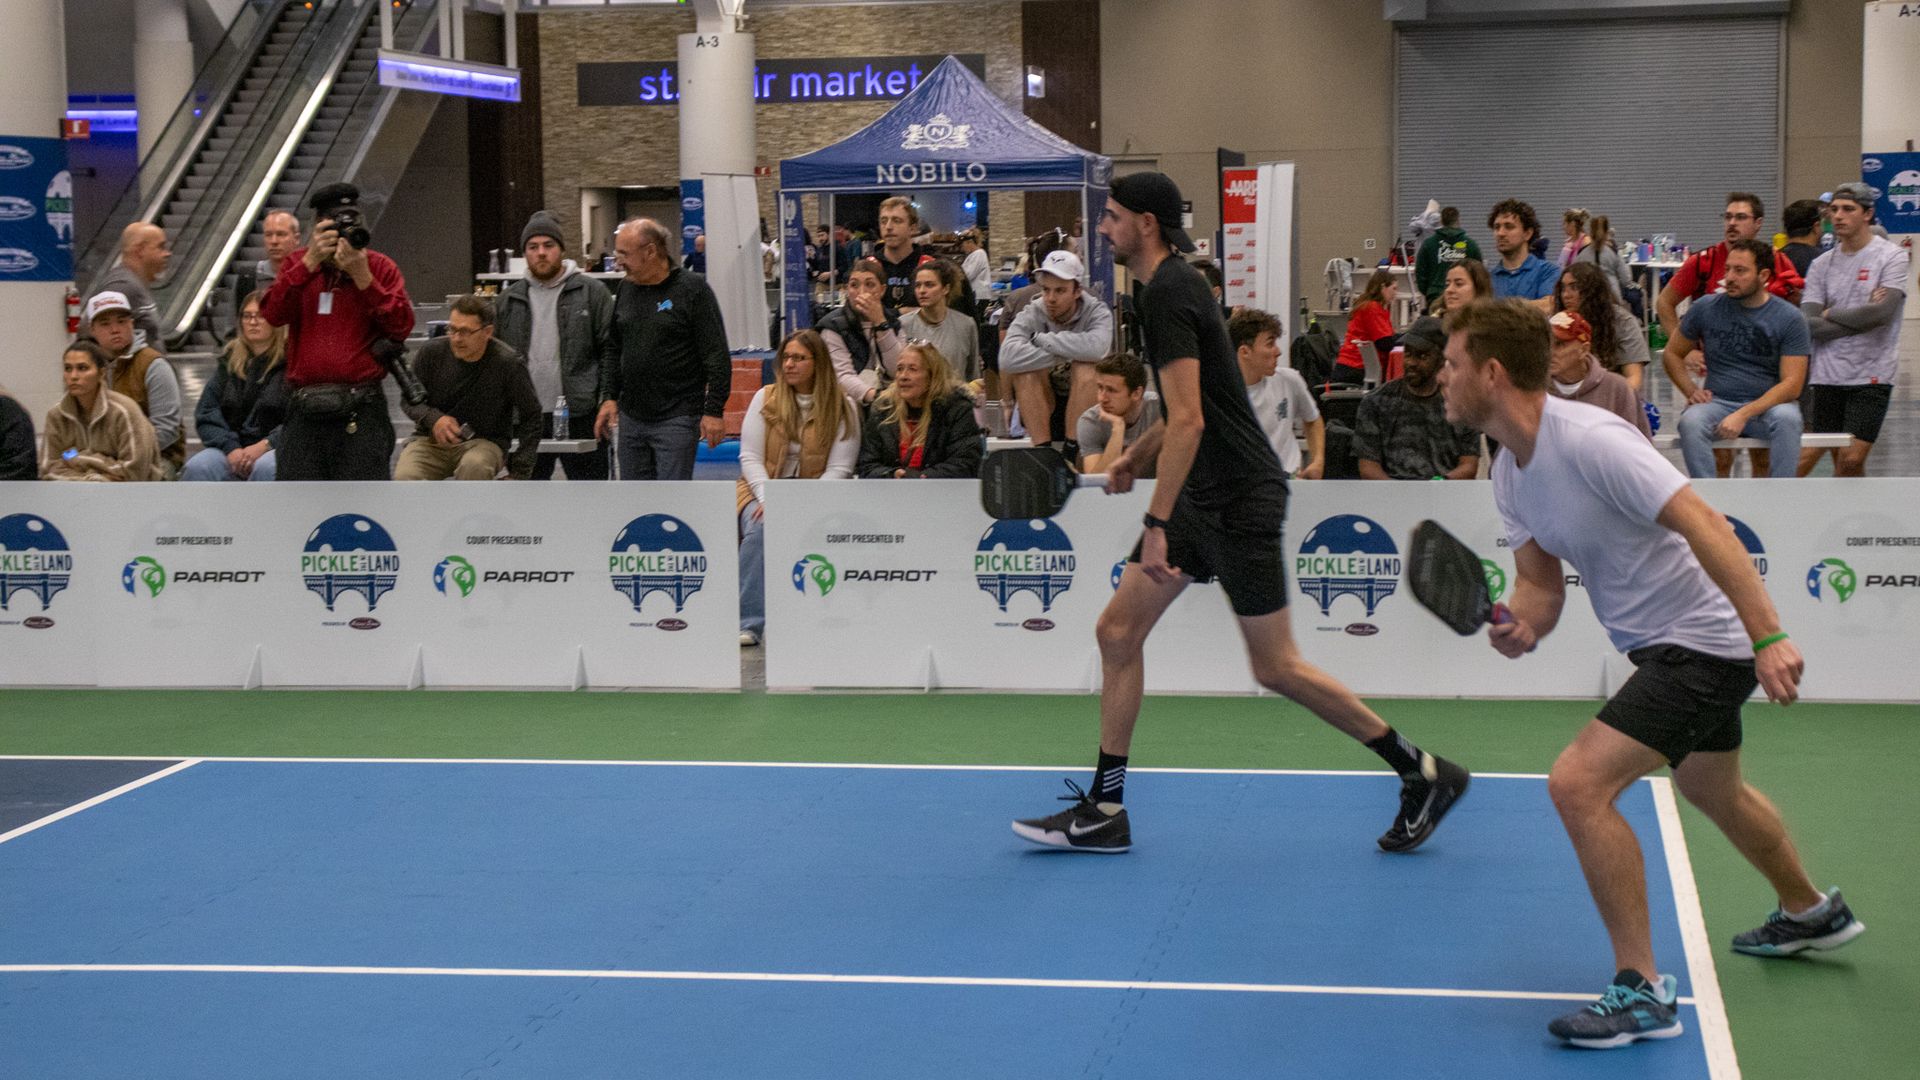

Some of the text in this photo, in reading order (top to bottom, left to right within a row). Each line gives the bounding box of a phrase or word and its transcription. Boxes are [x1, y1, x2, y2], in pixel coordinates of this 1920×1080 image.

[696, 35, 719, 48] A-3
[790, 63, 923, 97] market
[931, 127, 945, 136] N
[876, 161, 986, 184] NOBILO
[41, 554, 72, 571] LAND
[302, 555, 359, 572] PICKLE
[368, 554, 400, 572] LAND
[609, 556, 666, 572] PICKLE
[675, 555, 707, 572] LAND
[975, 555, 1034, 572] PICKLE
[1043, 555, 1076, 572] LAND
[1296, 558, 1357, 575] PICKLE
[1367, 558, 1401, 576] LAND
[173, 571, 265, 583] PARROT
[483, 571, 575, 583] PARROT
[843, 570, 937, 582] PARROT
